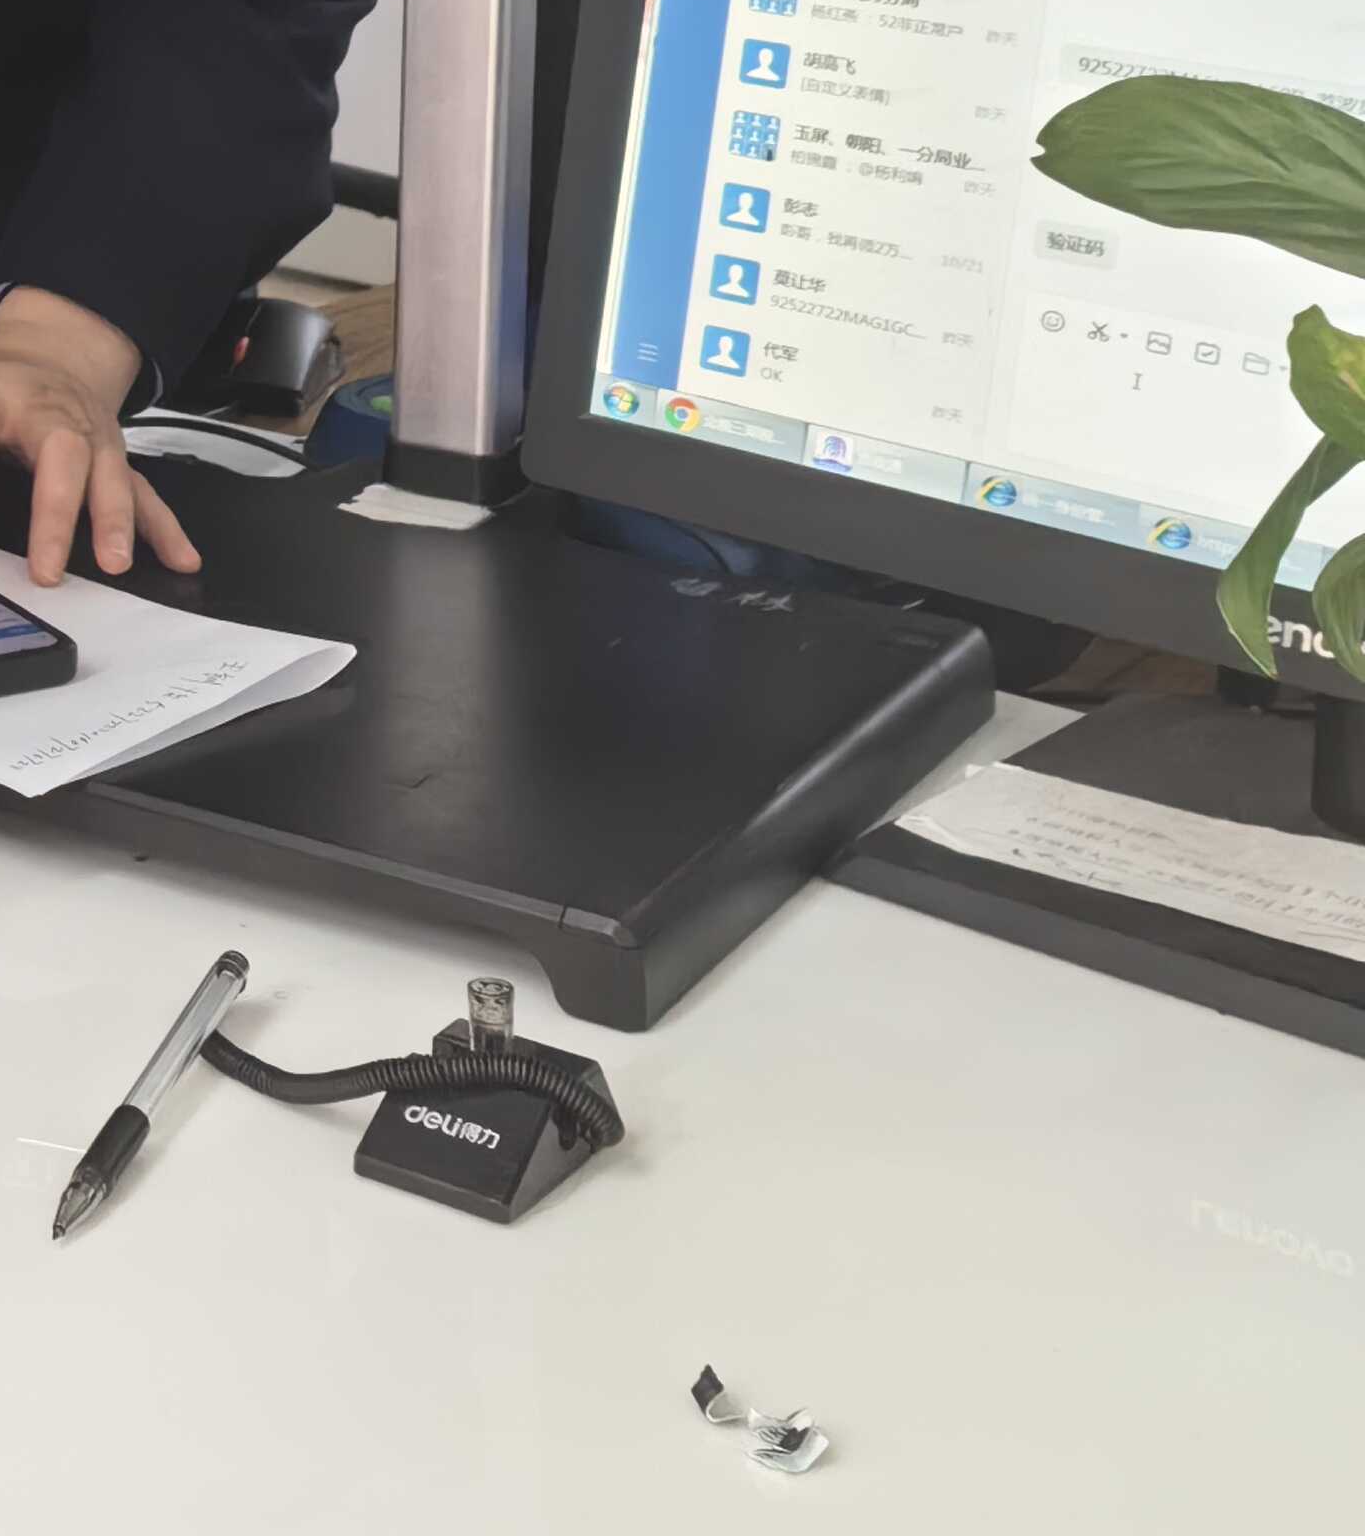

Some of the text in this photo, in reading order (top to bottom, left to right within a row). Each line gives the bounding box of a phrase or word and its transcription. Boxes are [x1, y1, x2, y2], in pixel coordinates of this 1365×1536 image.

[1045, 230, 1106, 258] 验证码
[760, 367, 784, 382] OK
